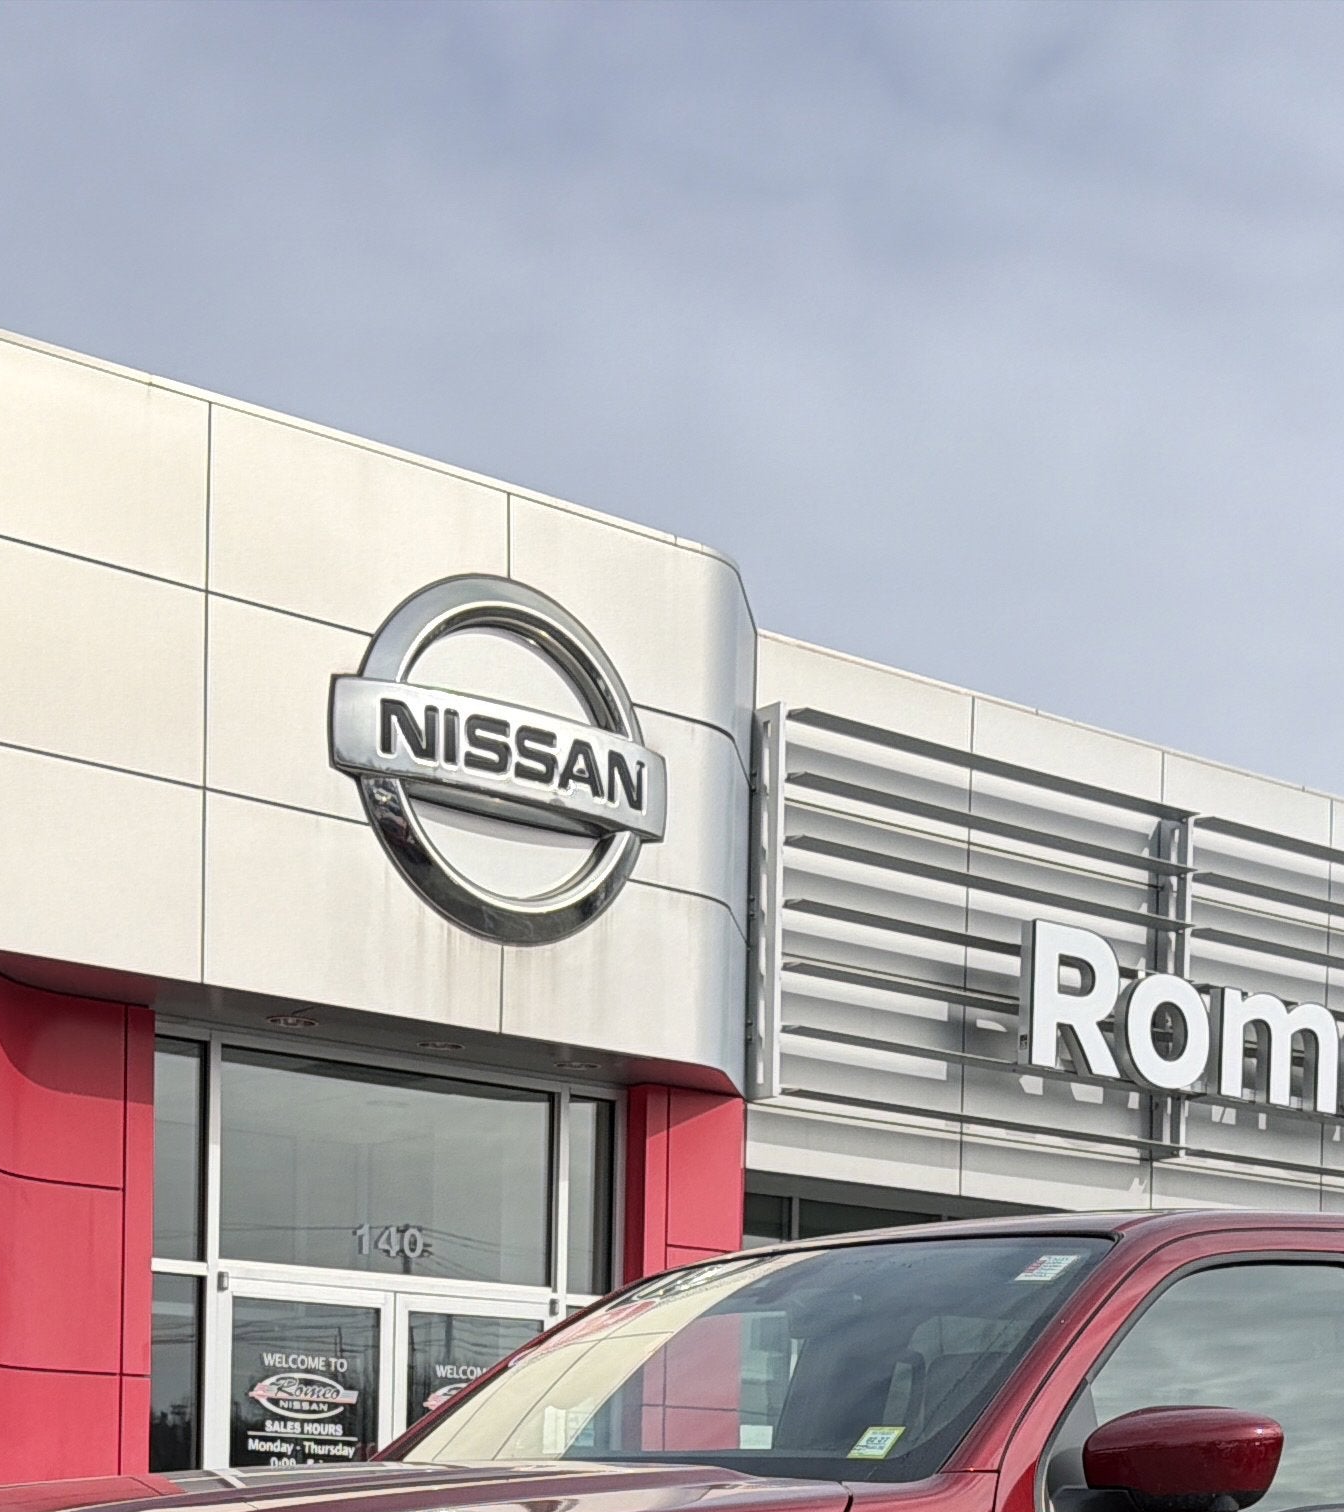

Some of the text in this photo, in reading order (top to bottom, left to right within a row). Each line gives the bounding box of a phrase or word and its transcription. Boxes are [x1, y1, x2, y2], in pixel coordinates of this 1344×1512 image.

[379, 698, 645, 811] NISSAN
[356, 1224, 423, 1257] 140
[263, 1352, 348, 1372] WELCOME TO
[270, 1377, 340, 1400] Romeo
[279, 1400, 328, 1412] NISSAN
[265, 1420, 343, 1436] SALES HOURS
[248, 1438, 294, 1455] Monday
[303, 1441, 355, 1458] Thursday
